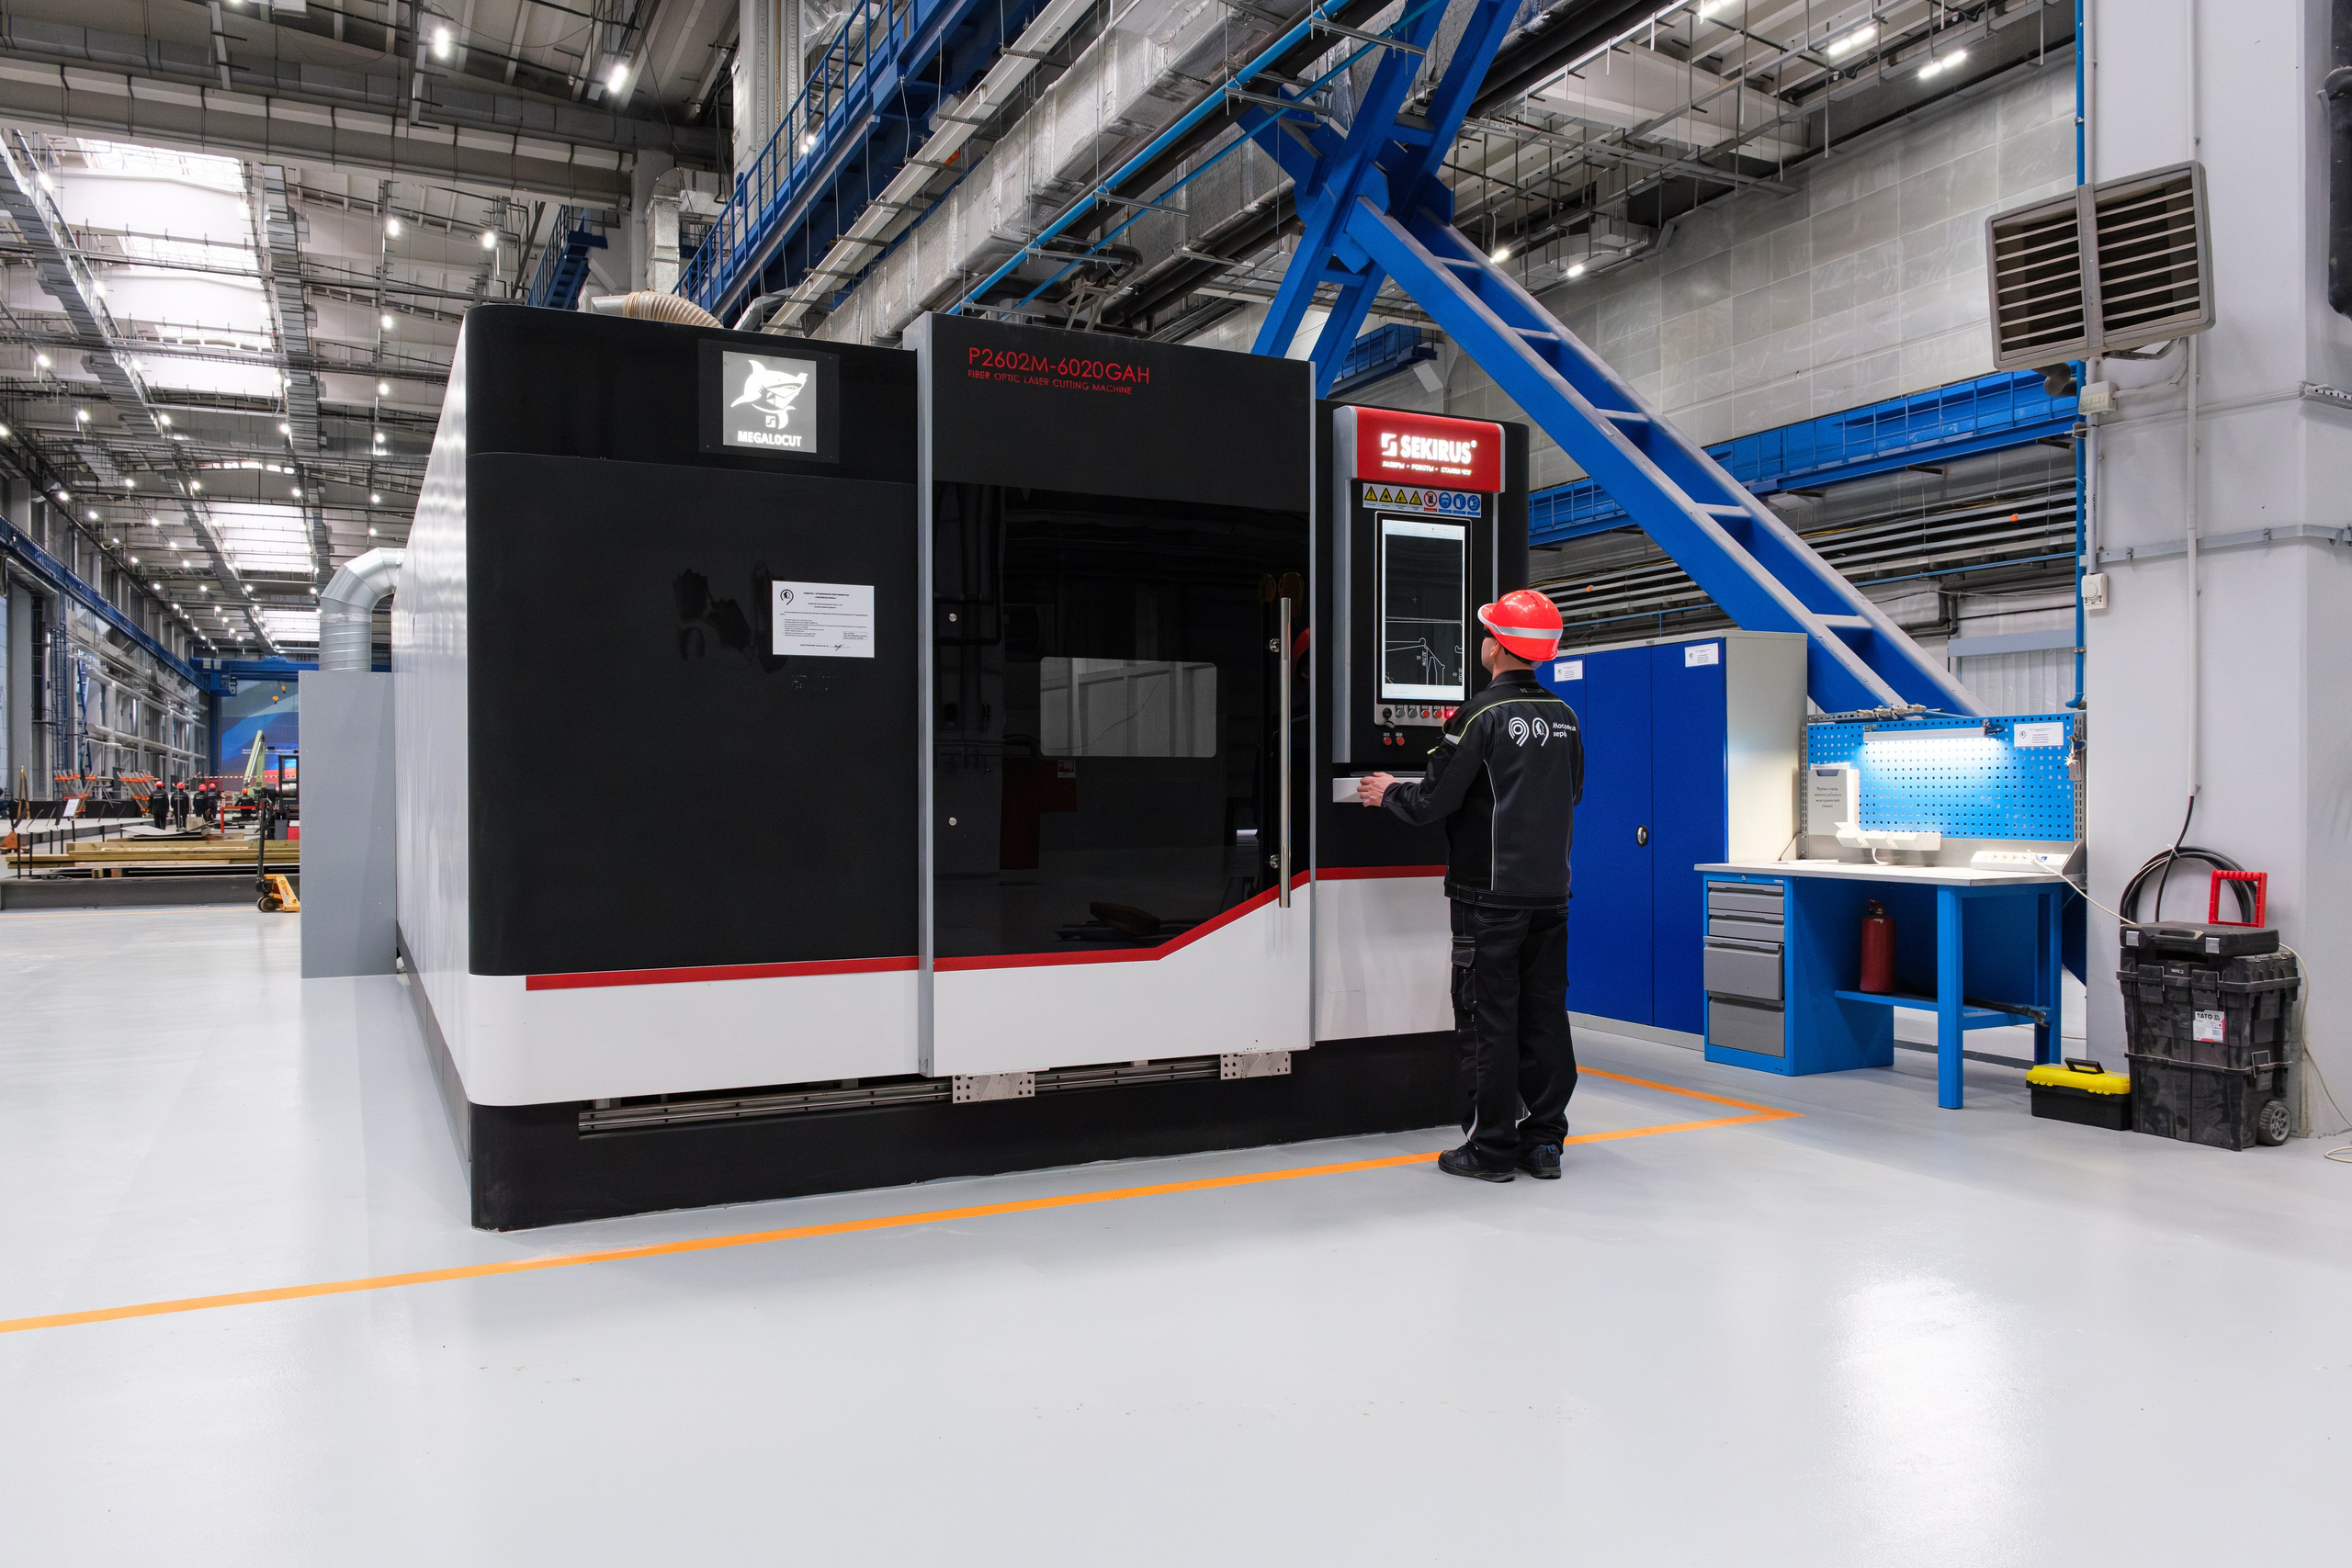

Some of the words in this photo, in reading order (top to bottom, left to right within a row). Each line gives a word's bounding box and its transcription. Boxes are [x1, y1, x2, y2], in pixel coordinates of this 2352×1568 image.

[968, 346, 1149, 385] P2602M-6020GAH
[968, 369, 990, 380] FIBER
[994, 373, 1020, 383] OPTIC
[1024, 376, 1049, 386] LASER
[1053, 378, 1089, 390] CUTTING
[1092, 383, 1132, 395] MACHINE
[738, 431, 802, 446] MEGALOCUT
